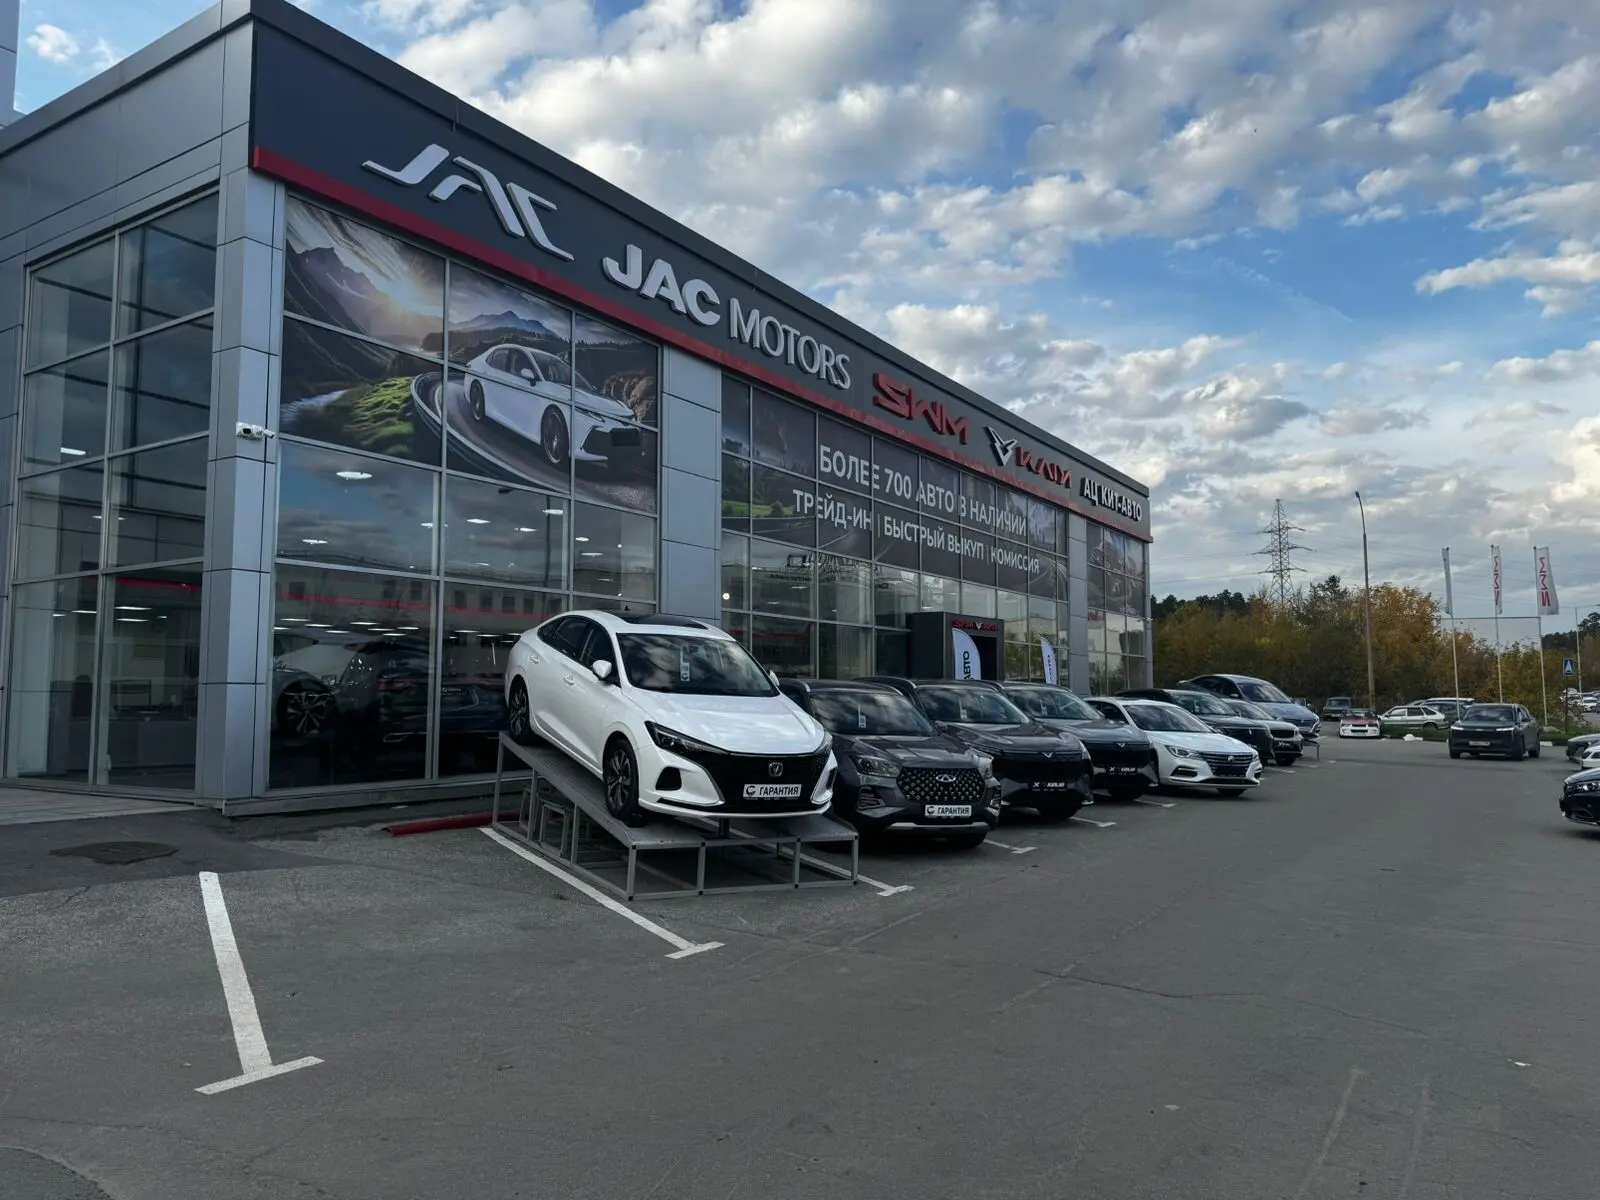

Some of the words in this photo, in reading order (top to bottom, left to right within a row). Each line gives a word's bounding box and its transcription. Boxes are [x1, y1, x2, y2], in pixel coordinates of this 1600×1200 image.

[602, 244, 721, 327] JAC
[729, 298, 851, 390] MOTORS
[873, 373, 970, 445] SWM
[820, 444, 880, 490] БОЛЕЕ
[884, 467, 912, 500] 700
[915, 481, 955, 513] АВТО
[960, 495, 967, 517] В
[970, 499, 1027, 537] НАЛИЧИИ
[1082, 477, 1099, 507] АЦ
[1101, 485, 1143, 522] КИТ-АВТО
[792, 489, 873, 530] ТРЕЙД-ИН
[884, 515, 945, 550] БЫСТРЫЙ
[947, 533, 984, 560] ВЫКУП
[991, 546, 1040, 574] КОМИССИЯ
[759, 786, 799, 796] ГАРАНТИЯ
[937, 807, 970, 815] ГАРАНТИЯ
